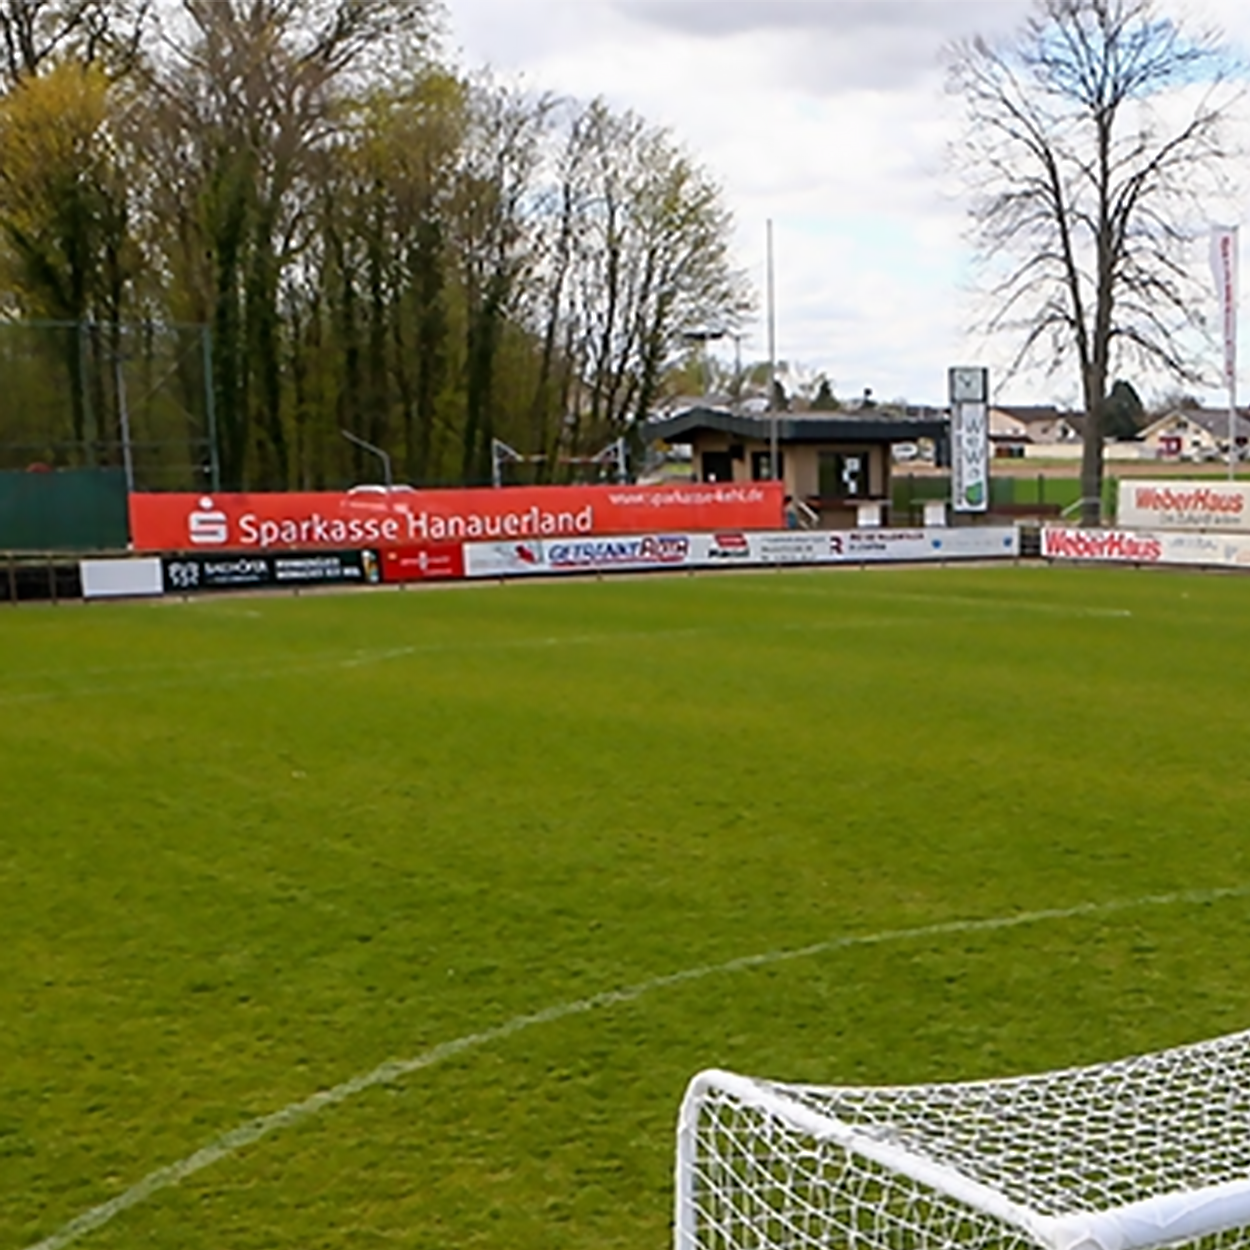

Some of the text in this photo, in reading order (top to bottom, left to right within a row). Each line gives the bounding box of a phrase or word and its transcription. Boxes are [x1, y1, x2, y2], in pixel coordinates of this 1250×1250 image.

[1135, 487, 1244, 513] WeberHaus
[238, 506, 593, 547] Sparkasse Hanauerland
[1045, 528, 1162, 562] WeberHaus
